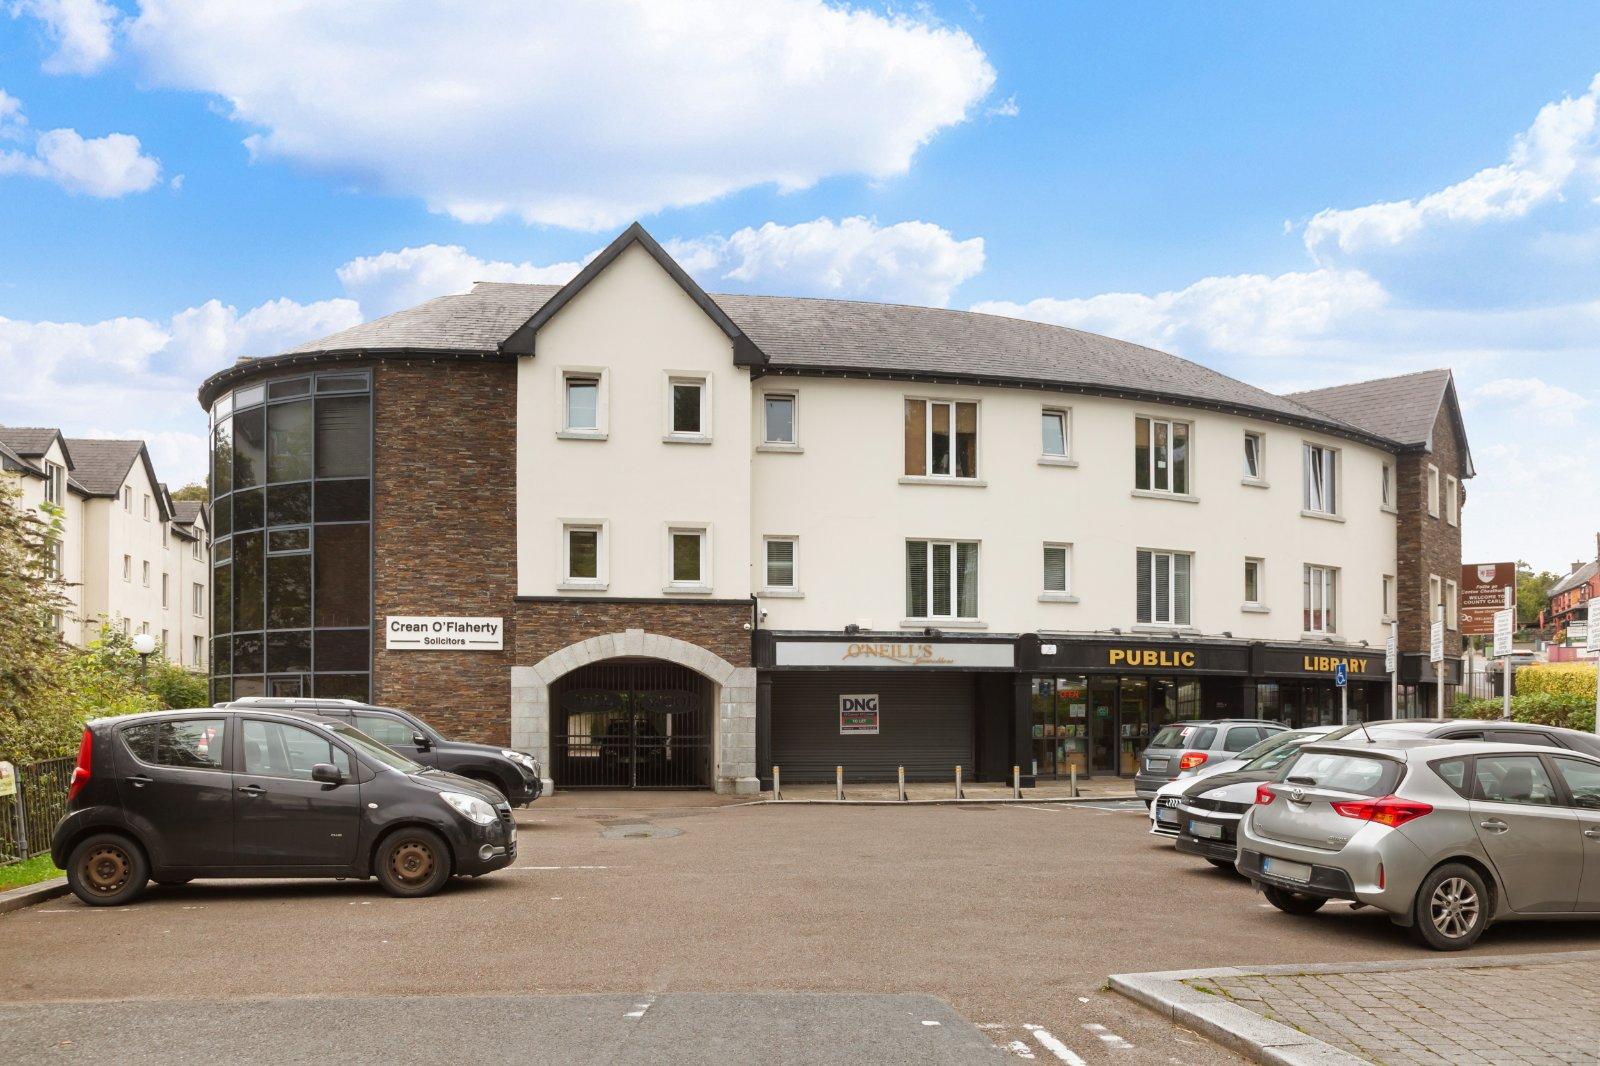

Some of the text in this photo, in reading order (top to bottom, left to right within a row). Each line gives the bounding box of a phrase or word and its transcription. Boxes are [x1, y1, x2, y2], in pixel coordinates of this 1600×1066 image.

[391, 621, 498, 635] Crean O'Flaherty
[424, 637, 466, 645] Solicitors
[843, 643, 933, 660] O'NEILL'S
[1109, 649, 1196, 667] PUBLIC
[1304, 656, 1367, 672] LIBRARY
[842, 698, 877, 711] DNG
